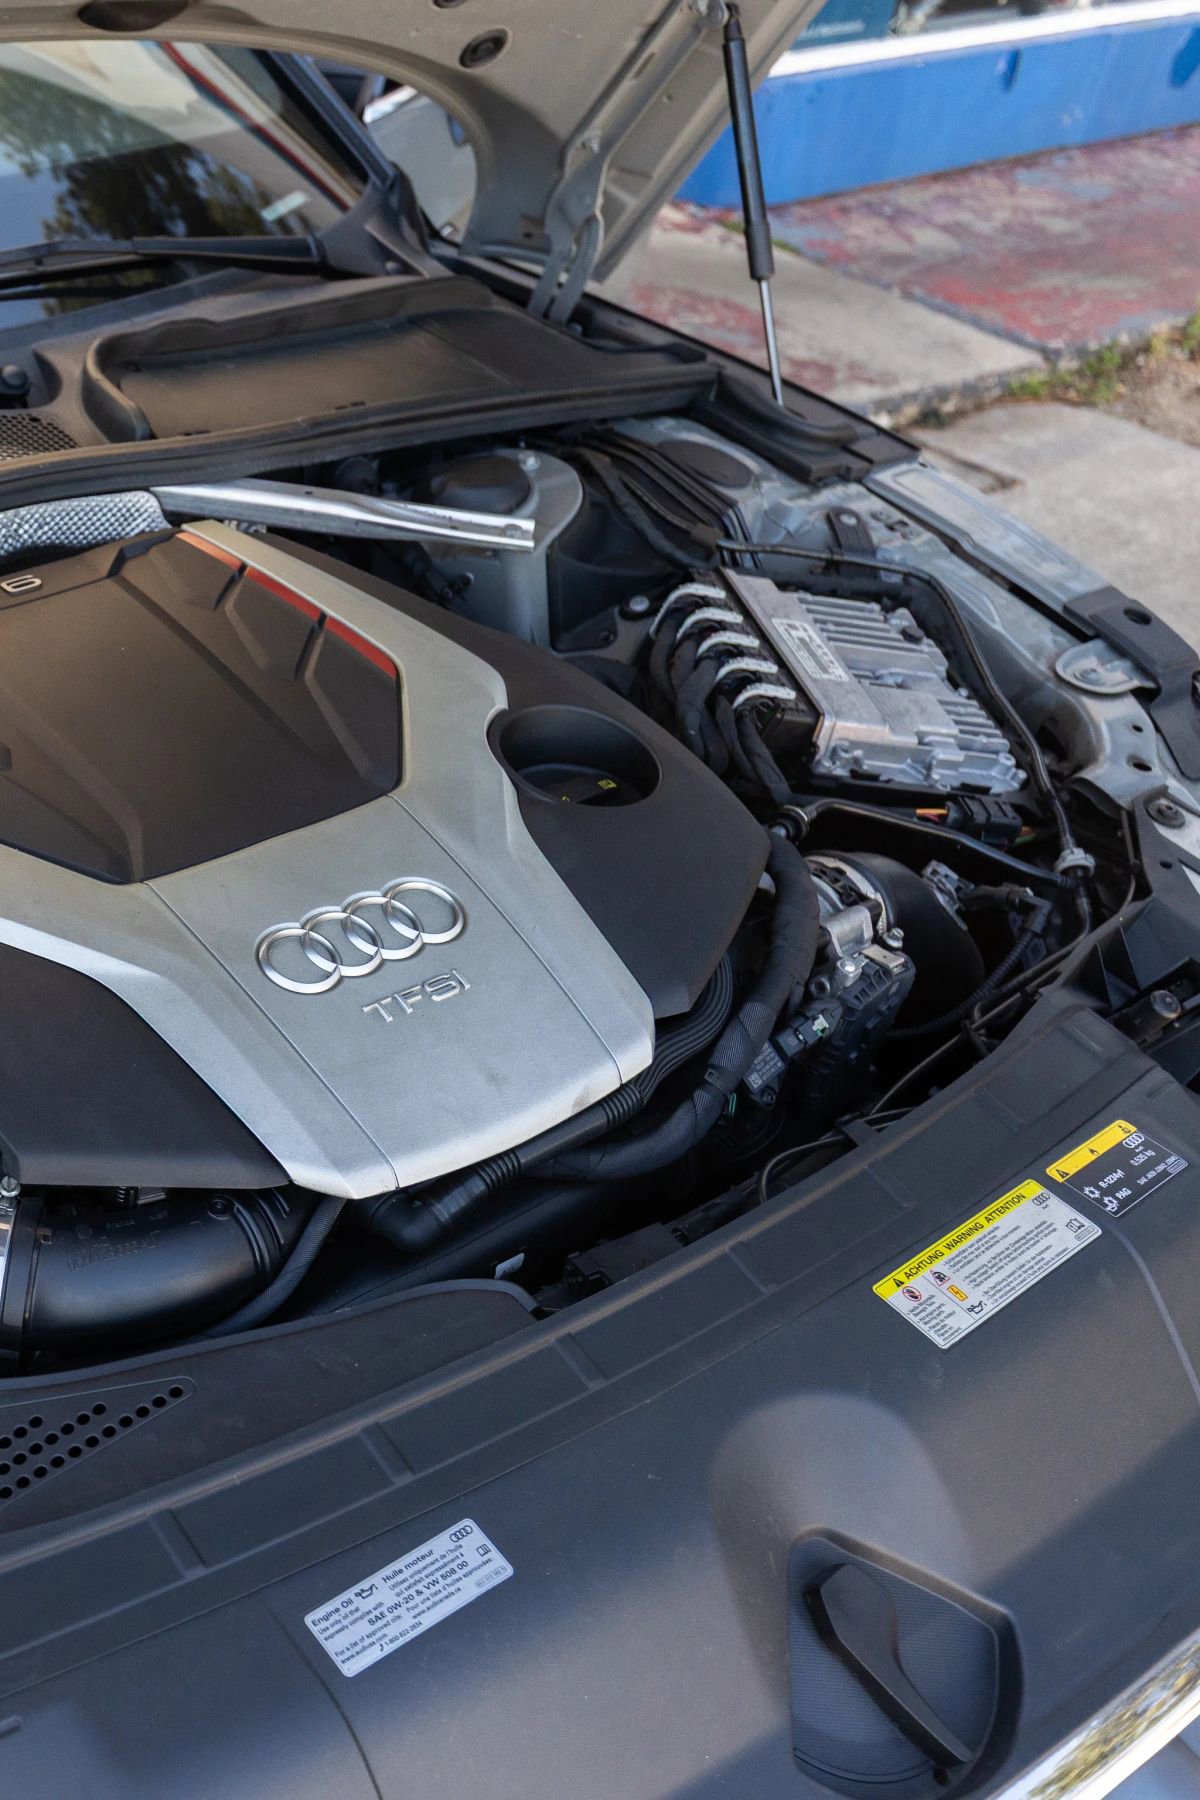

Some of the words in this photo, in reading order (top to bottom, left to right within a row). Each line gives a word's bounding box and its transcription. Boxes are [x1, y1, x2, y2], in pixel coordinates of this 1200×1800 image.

[362, 969, 471, 1022] TFSI
[1098, 1169, 1125, 1188] R-1234yf
[1115, 1188, 1132, 1200] PAG
[904, 1249, 945, 1280] ACHTUNG
[943, 1222, 984, 1251] WARNING
[984, 1193, 1026, 1224] ATTENTION
[382, 1568, 404, 1583] Huile
[404, 1549, 434, 1570] moteur
[367, 1611, 387, 1626] SAE
[386, 1594, 415, 1614] 0W-20
[423, 1577, 440, 1590] VW
[456, 1560, 469, 1570] 00
[311, 1607, 341, 1627] Engine
[340, 1598, 354, 1608] Oil
[317, 1626, 330, 1635] Use
[329, 1618, 342, 1628] only
[348, 1606, 360, 1616] that
